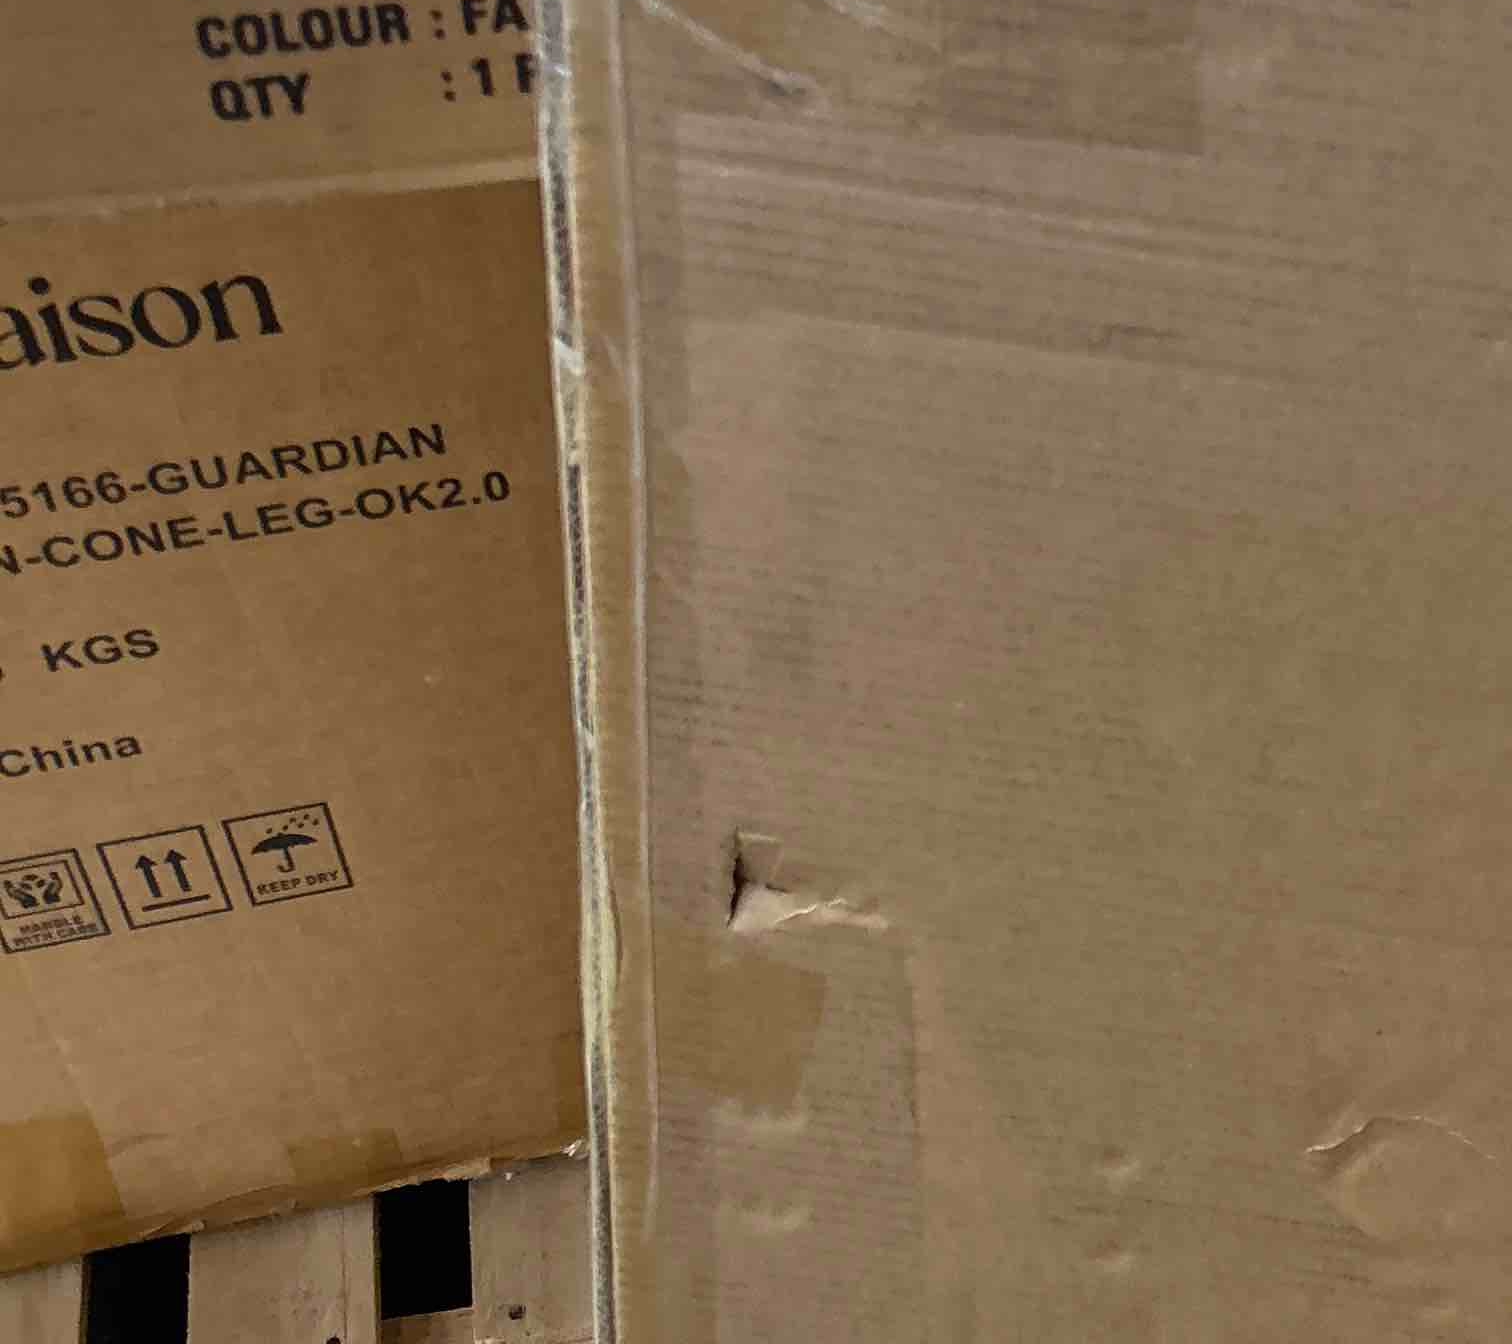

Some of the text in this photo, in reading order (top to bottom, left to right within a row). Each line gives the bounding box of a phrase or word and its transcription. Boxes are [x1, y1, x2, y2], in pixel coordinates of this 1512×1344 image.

[196, 1, 412, 59] COLOUR
[209, 73, 311, 122] QTY
[0, 422, 447, 520] 5166-GUARDIAN
[41, 628, 161, 674] KGS
[0, 733, 143, 779] China
[256, 869, 340, 897] KEEP DRY
